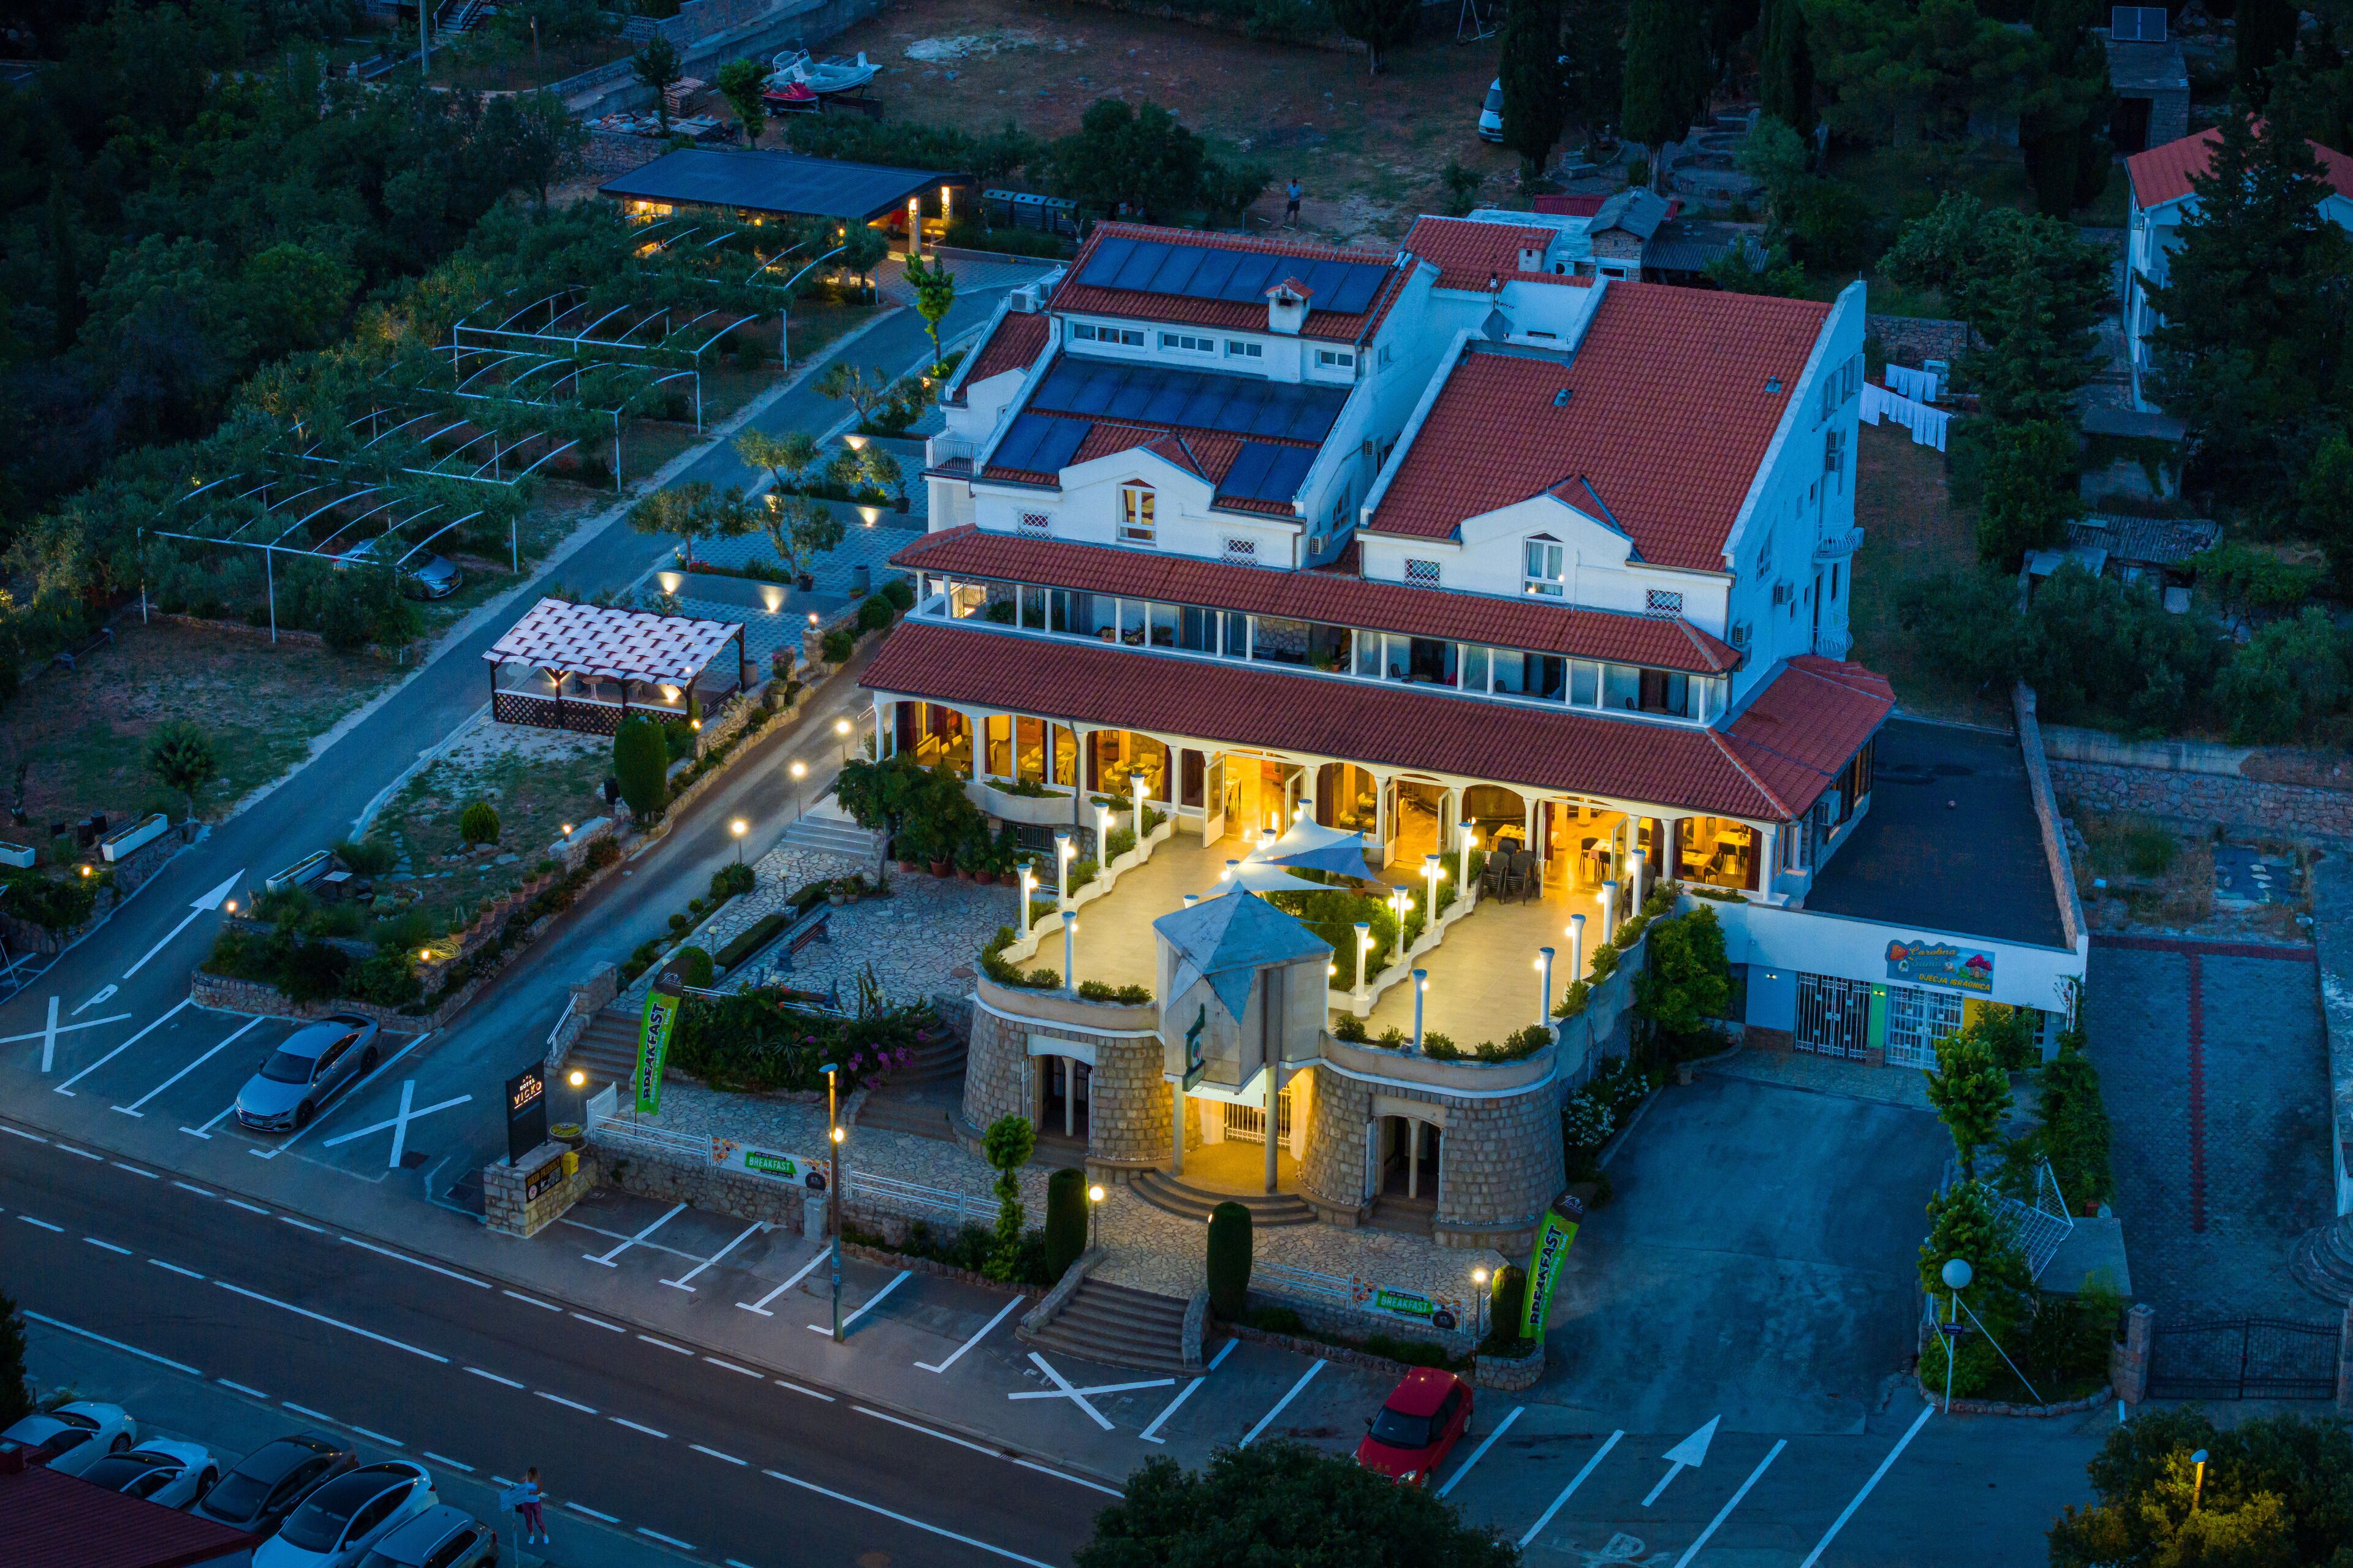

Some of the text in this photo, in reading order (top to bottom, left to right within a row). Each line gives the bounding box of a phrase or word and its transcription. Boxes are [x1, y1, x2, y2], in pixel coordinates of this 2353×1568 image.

[643, 1001, 666, 1100] BREAKFAST
[514, 1081, 542, 1104] VICKO
[520, 1078, 536, 1091] HOTEL
[749, 1156, 790, 1172] BREAKFAST
[1529, 1224, 1563, 1325] BREAKFAST
[1381, 1295, 1428, 1312] BREAKFAST
